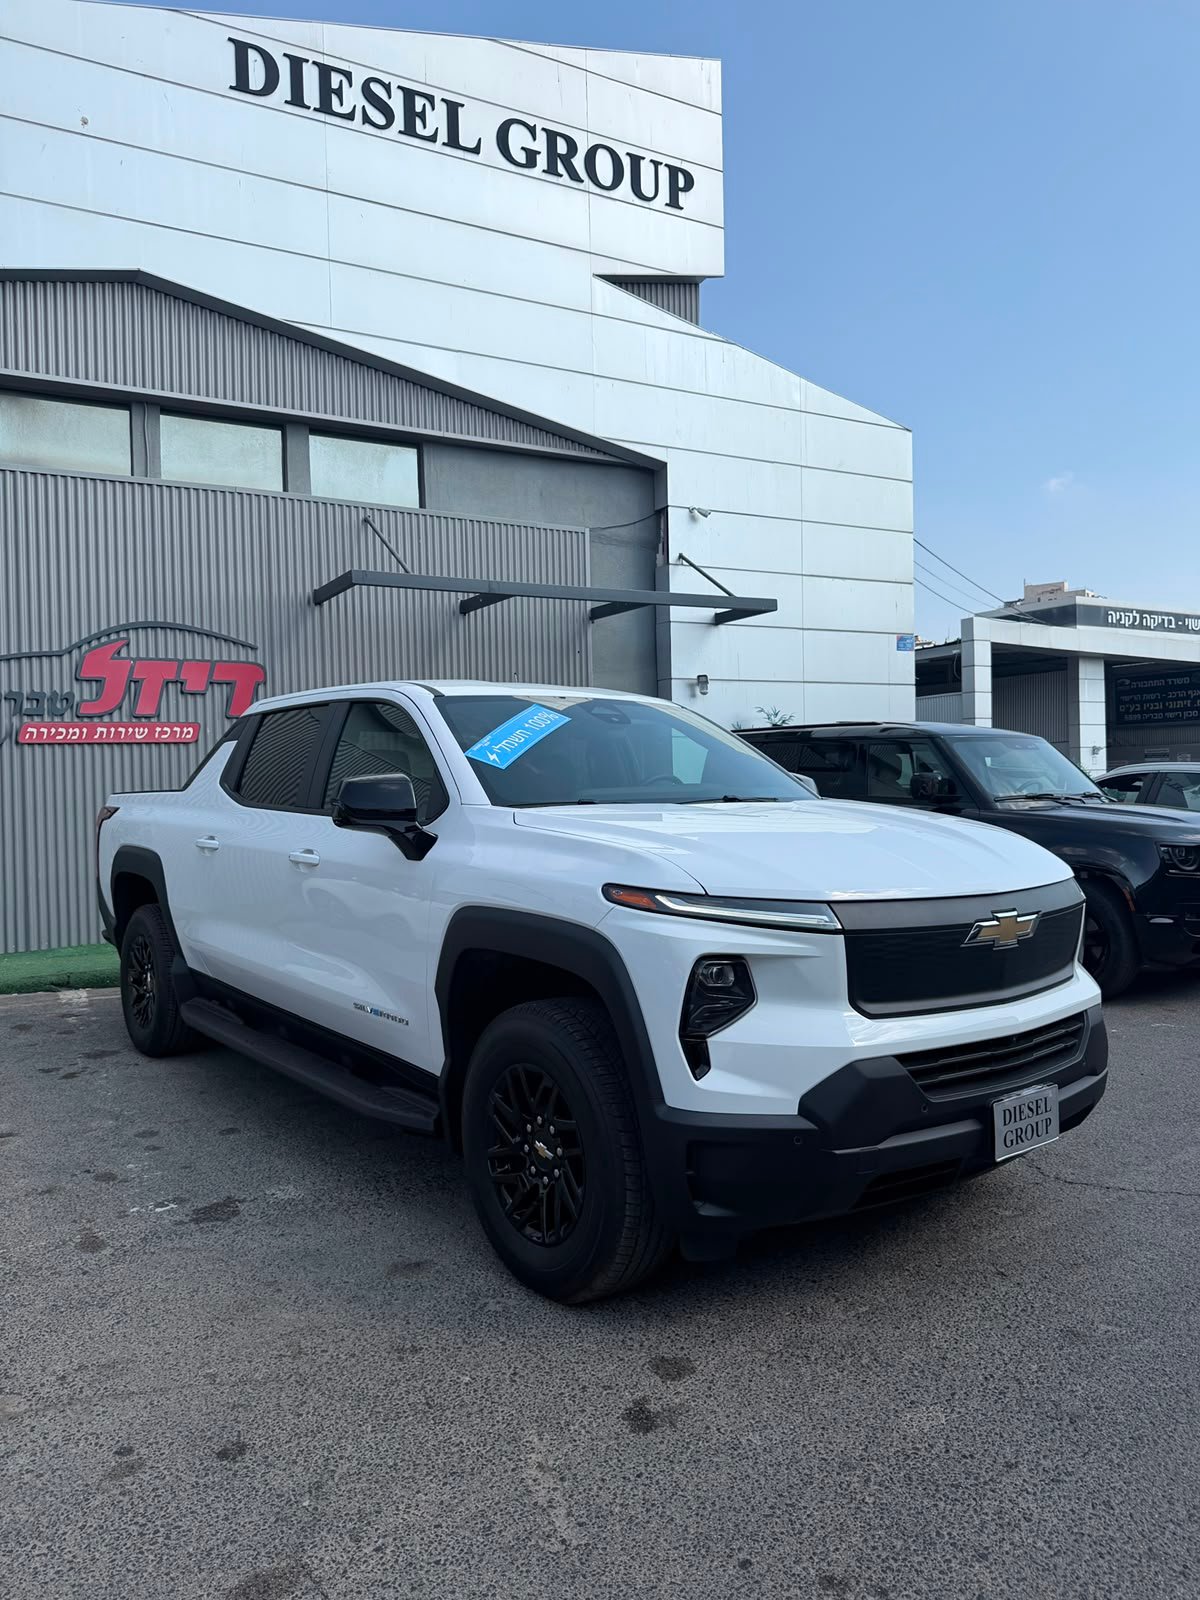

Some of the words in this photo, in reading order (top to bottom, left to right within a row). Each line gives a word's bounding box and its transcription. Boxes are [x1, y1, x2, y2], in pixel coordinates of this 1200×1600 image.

[227, 37, 481, 155] DIESEL
[496, 118, 694, 210] GROUP
[1107, 610, 1140, 627] לקניה
[1142, 614, 1176, 629] בדיקה
[76, 637, 267, 718] דיזל
[1167, 677, 1190, 685] משרד
[0, 690, 75, 716] טבר
[524, 711, 558, 730] 100%
[25, 727, 87, 740] ומכירה
[93, 726, 149, 740] שירות
[154, 726, 194, 739] מרכז
[492, 729, 533, 753] חשמלי
[1002, 1097, 1052, 1126] DIESEL
[1004, 1117, 1052, 1148] GROUP
